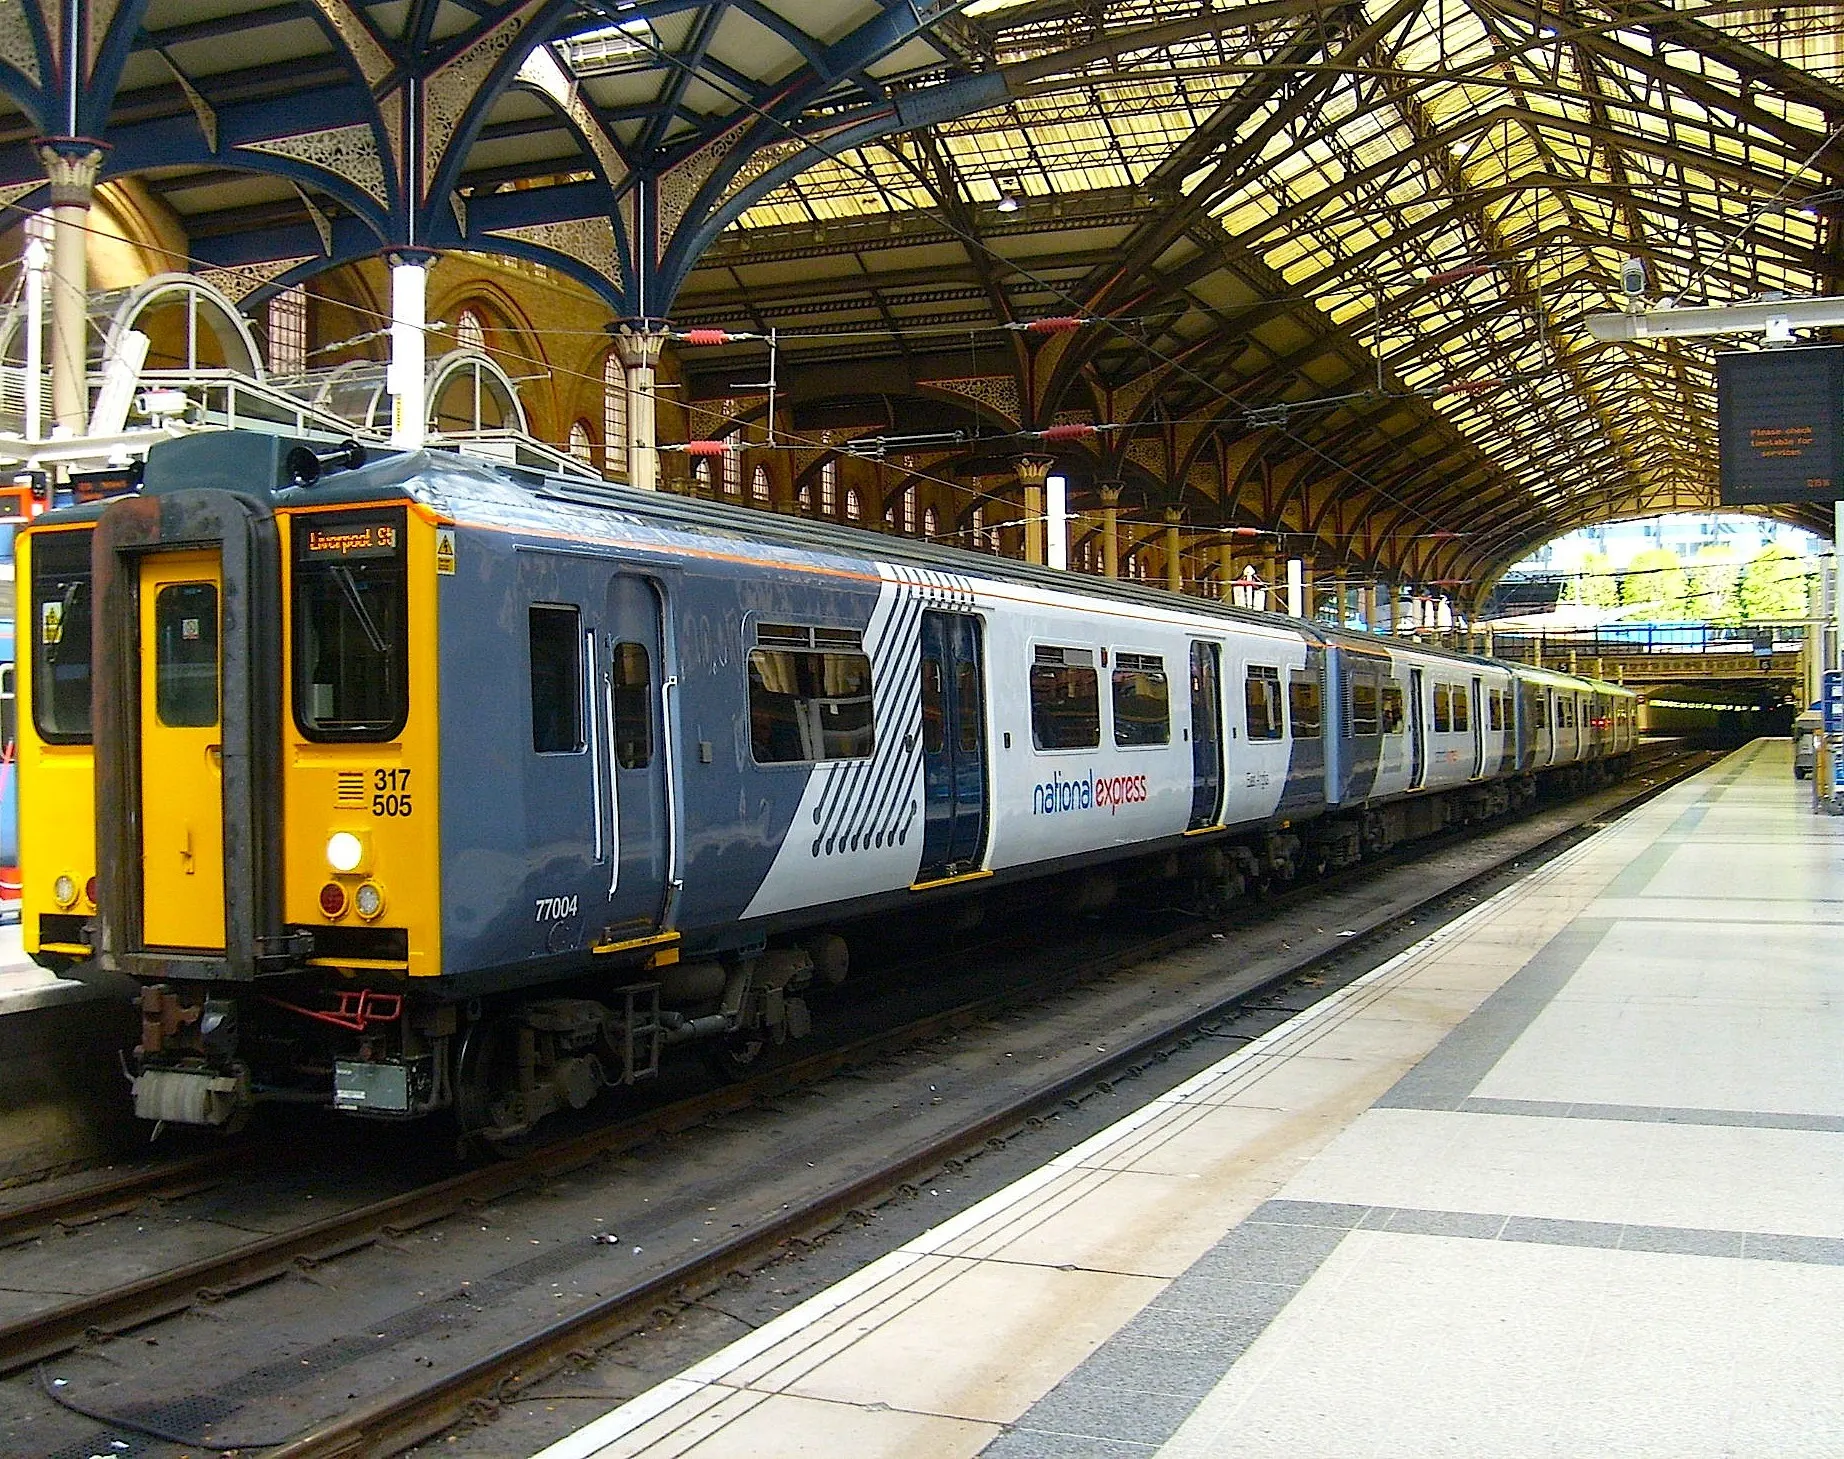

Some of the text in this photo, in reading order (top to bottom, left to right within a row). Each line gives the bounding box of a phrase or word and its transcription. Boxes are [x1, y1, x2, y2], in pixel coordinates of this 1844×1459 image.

[310, 529, 373, 553] Liverpool
[374, 768, 411, 791] 317
[1033, 768, 1147, 816] national express
[372, 794, 412, 817] 505
[535, 894, 578, 922] 77004
